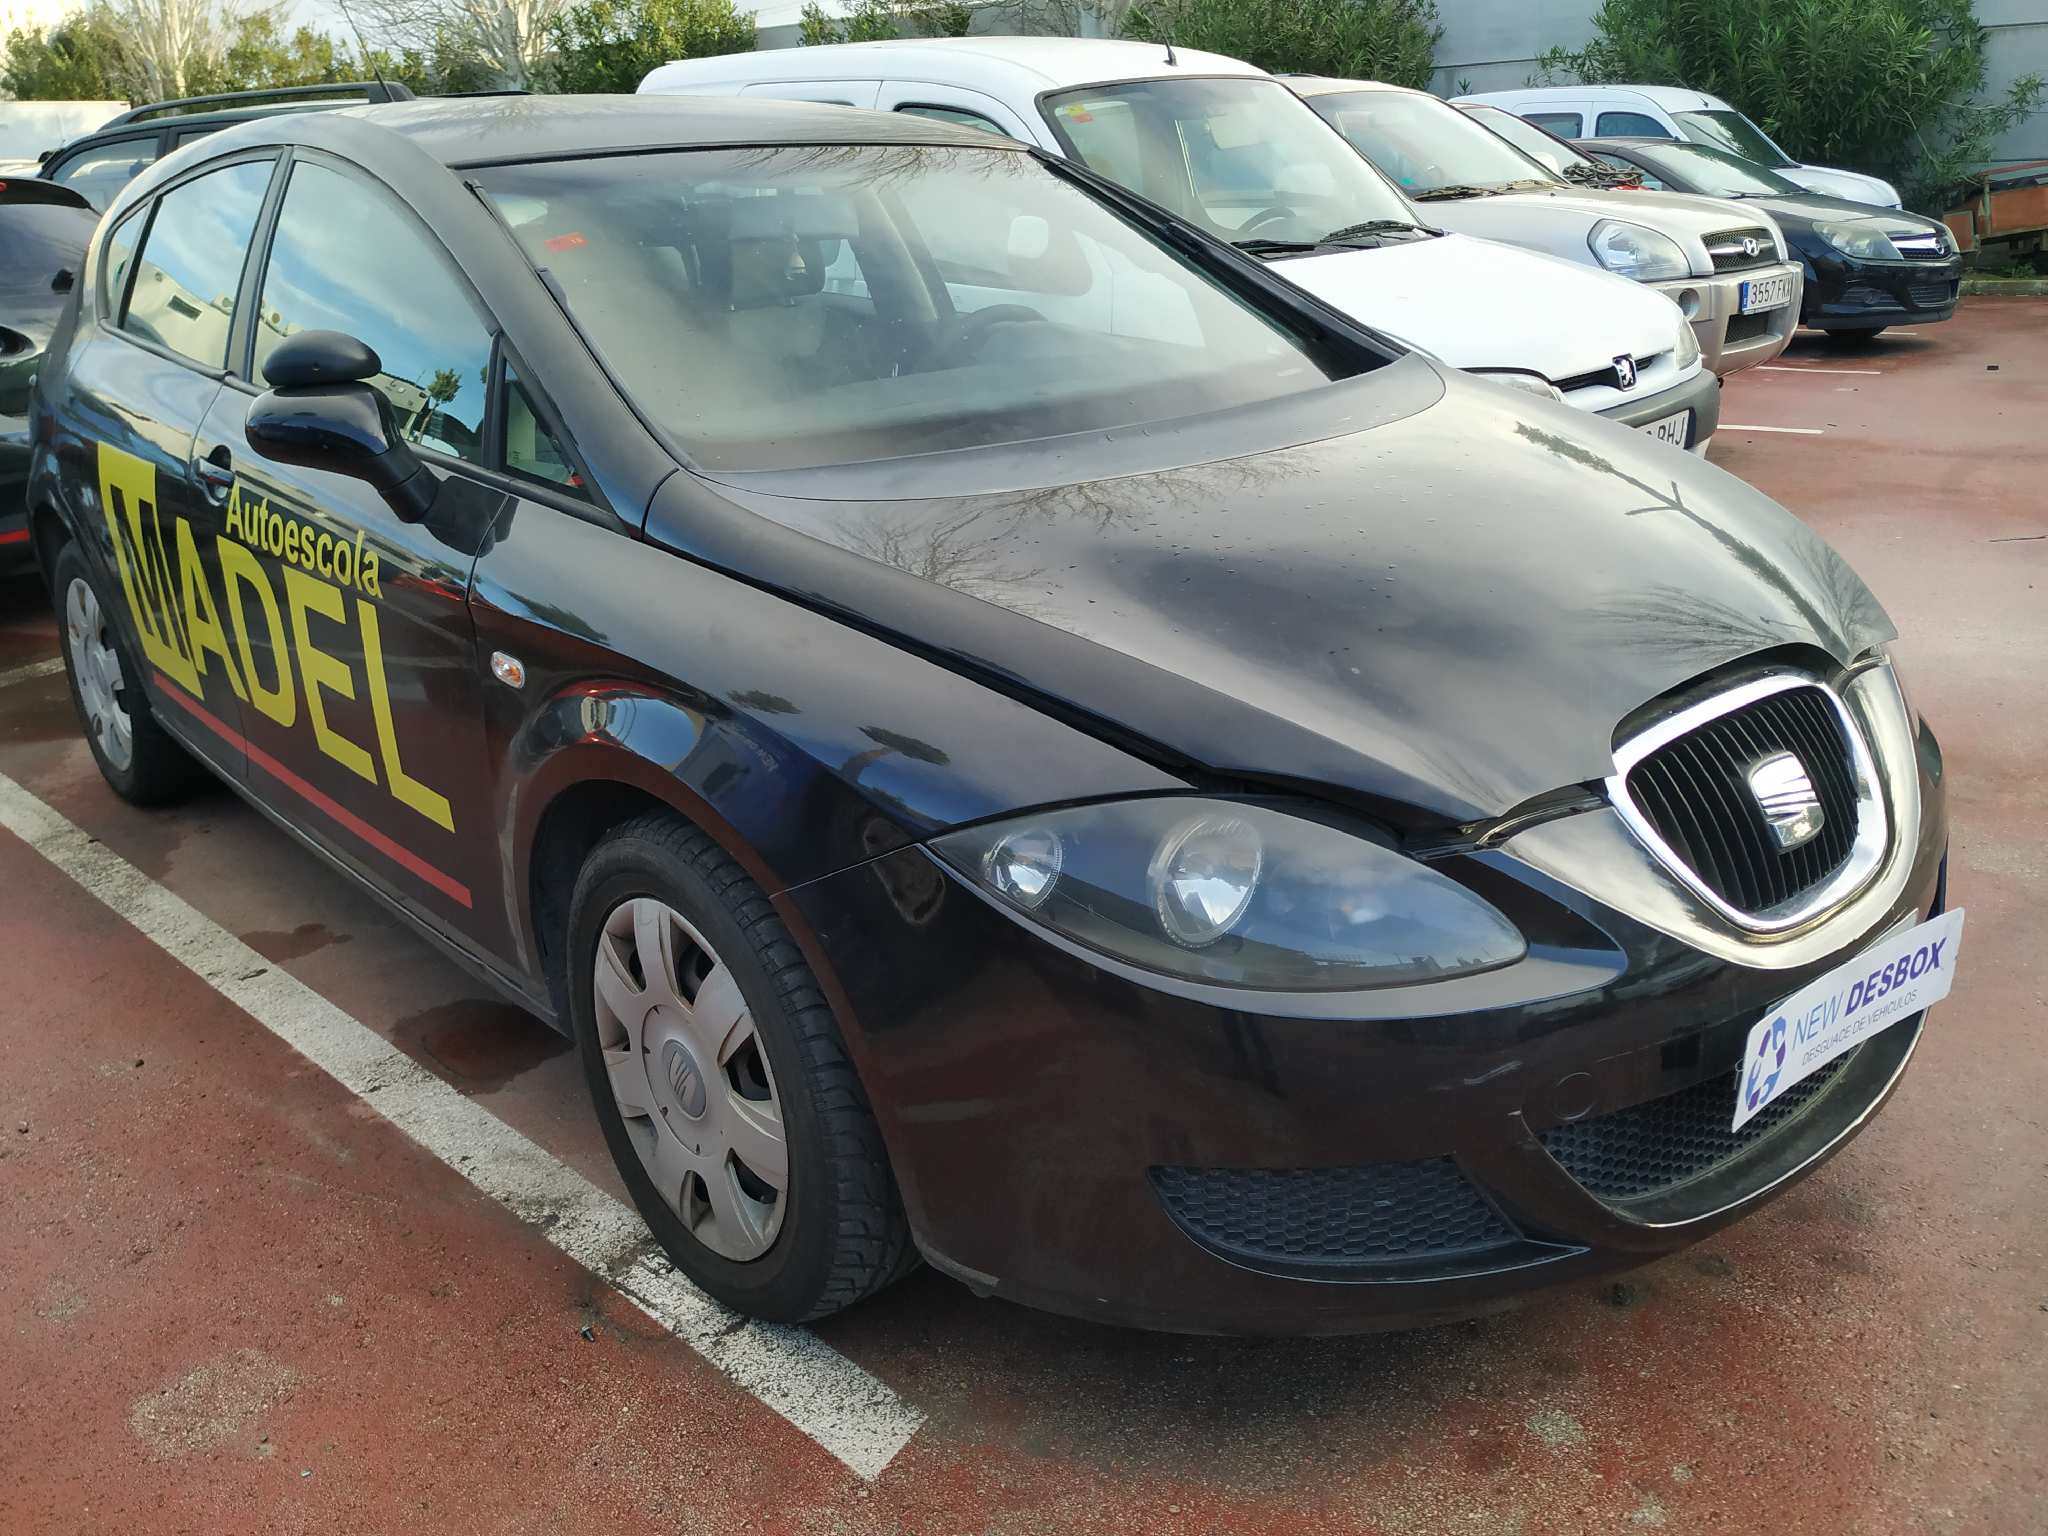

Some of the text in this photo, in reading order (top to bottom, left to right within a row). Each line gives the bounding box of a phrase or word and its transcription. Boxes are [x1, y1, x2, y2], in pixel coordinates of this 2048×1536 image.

[1751, 281, 1776, 304] 3557
[225, 483, 383, 600] Autoescola
[98, 441, 455, 833] MADEL
[1792, 936, 1947, 1050] NEW DESBOX
[1802, 1024, 1852, 1066] DESGUACE
[1852, 1015, 1866, 1035] DE
